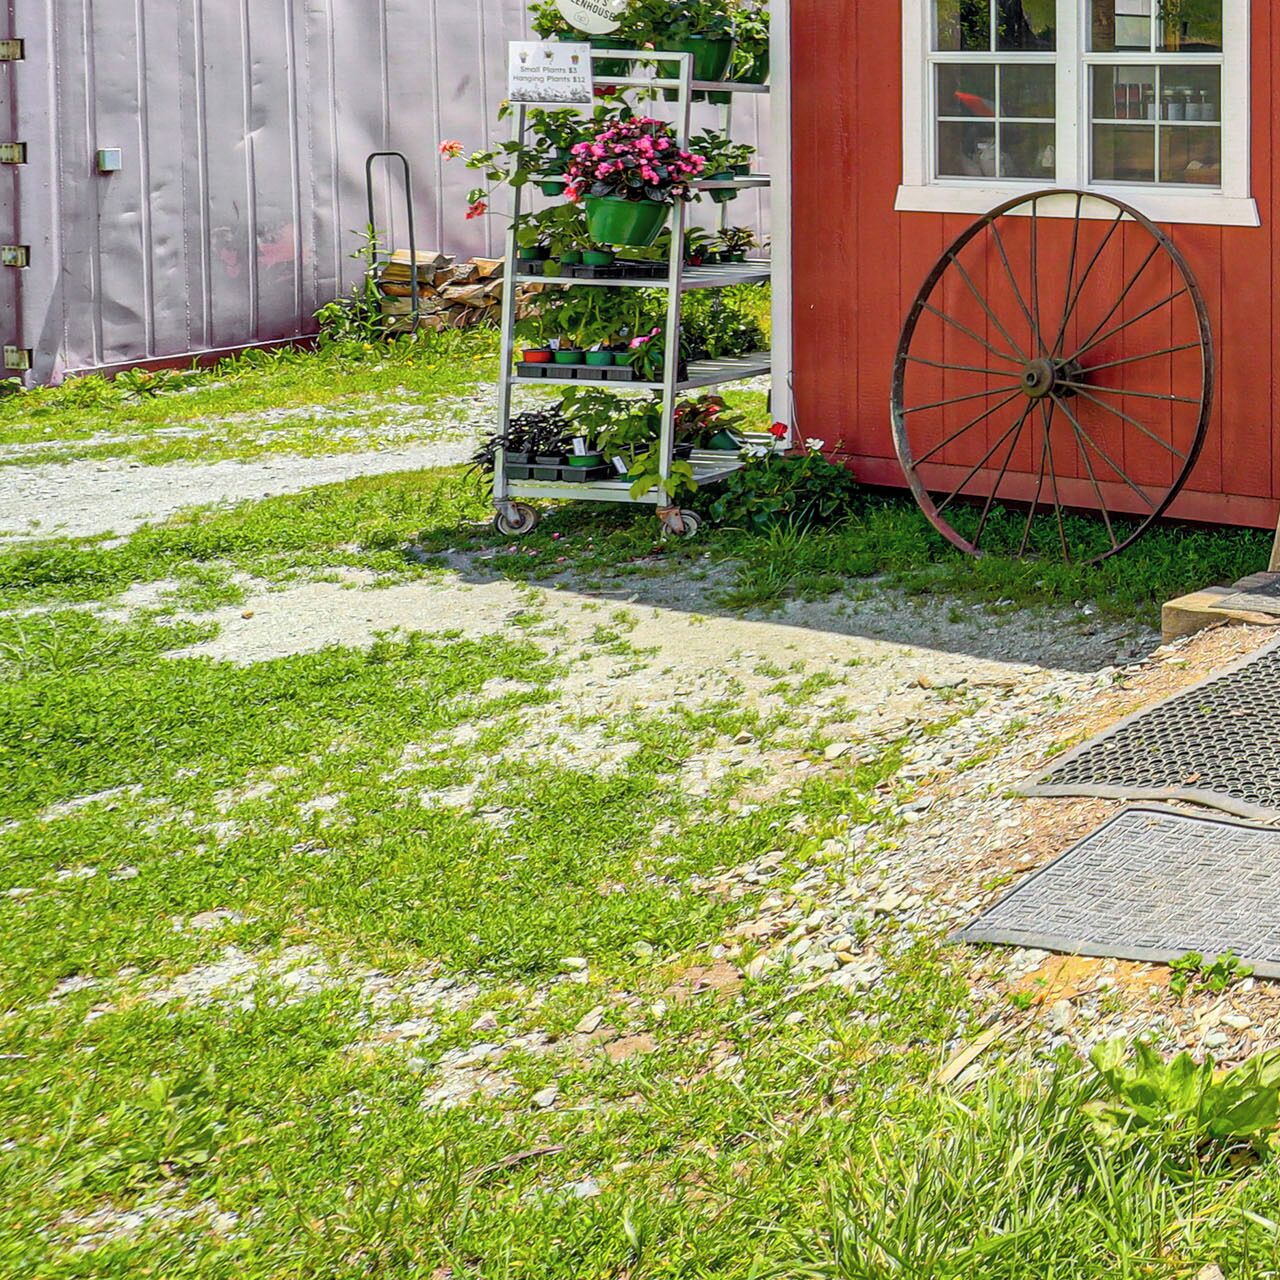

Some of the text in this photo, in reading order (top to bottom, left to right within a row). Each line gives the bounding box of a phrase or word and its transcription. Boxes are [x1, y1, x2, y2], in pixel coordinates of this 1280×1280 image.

[520, 65, 578, 75] Small Plants $3
[513, 75, 586, 84] Hanging Plants $12
